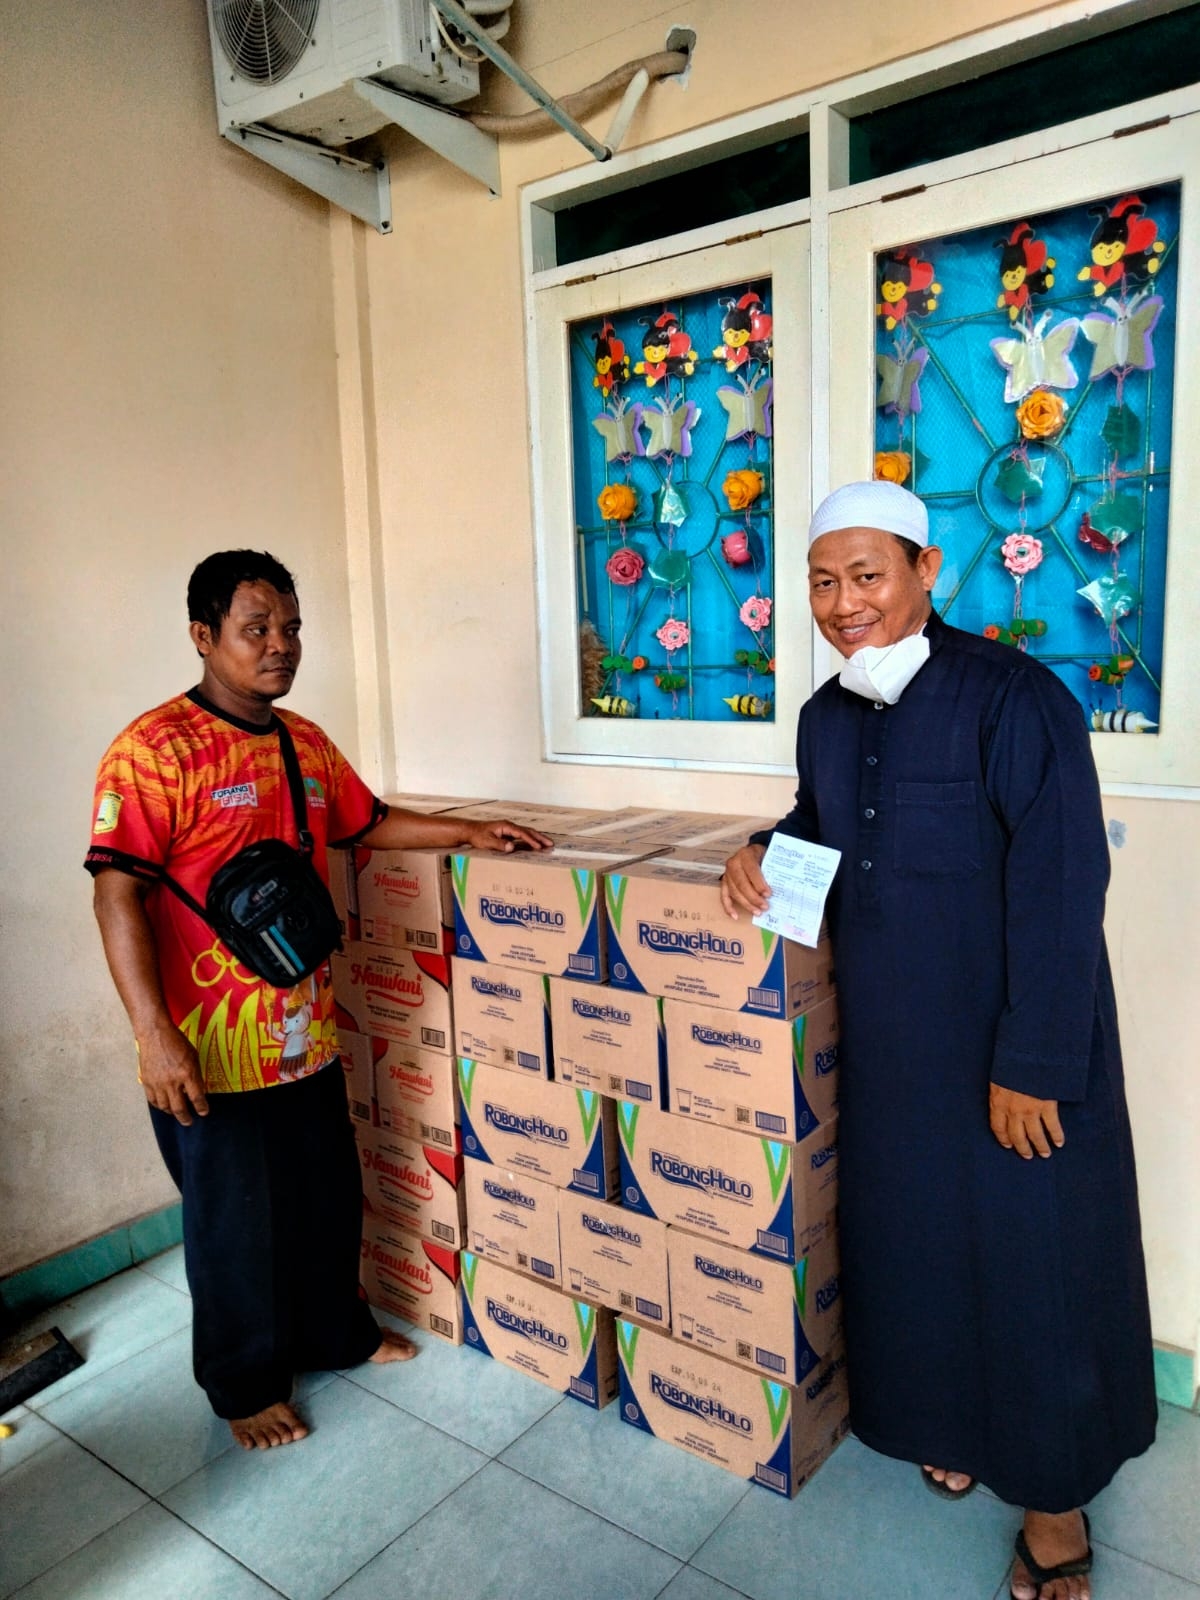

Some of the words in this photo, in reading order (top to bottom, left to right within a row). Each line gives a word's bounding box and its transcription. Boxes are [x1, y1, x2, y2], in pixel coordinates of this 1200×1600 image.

[212, 785, 248, 798] TORANG
[480, 897, 565, 927] ROBONGHOLO
[638, 922, 742, 956] ROBONGHOLO
[471, 976, 521, 998] ROBONGHOLO
[572, 999, 631, 1022] ROBONGHOLO
[692, 1025, 761, 1050] ROBONGHOLO
[485, 1103, 568, 1142] ROBONGHOLO
[651, 1151, 751, 1198] ROBONGHOLO
[582, 1214, 641, 1243] ROBONGHOLO
[695, 1256, 762, 1289] ROBONGHOLO
[487, 1299, 567, 1348] ROBONGHOLO
[651, 1373, 751, 1432] ROBONGHOLO
